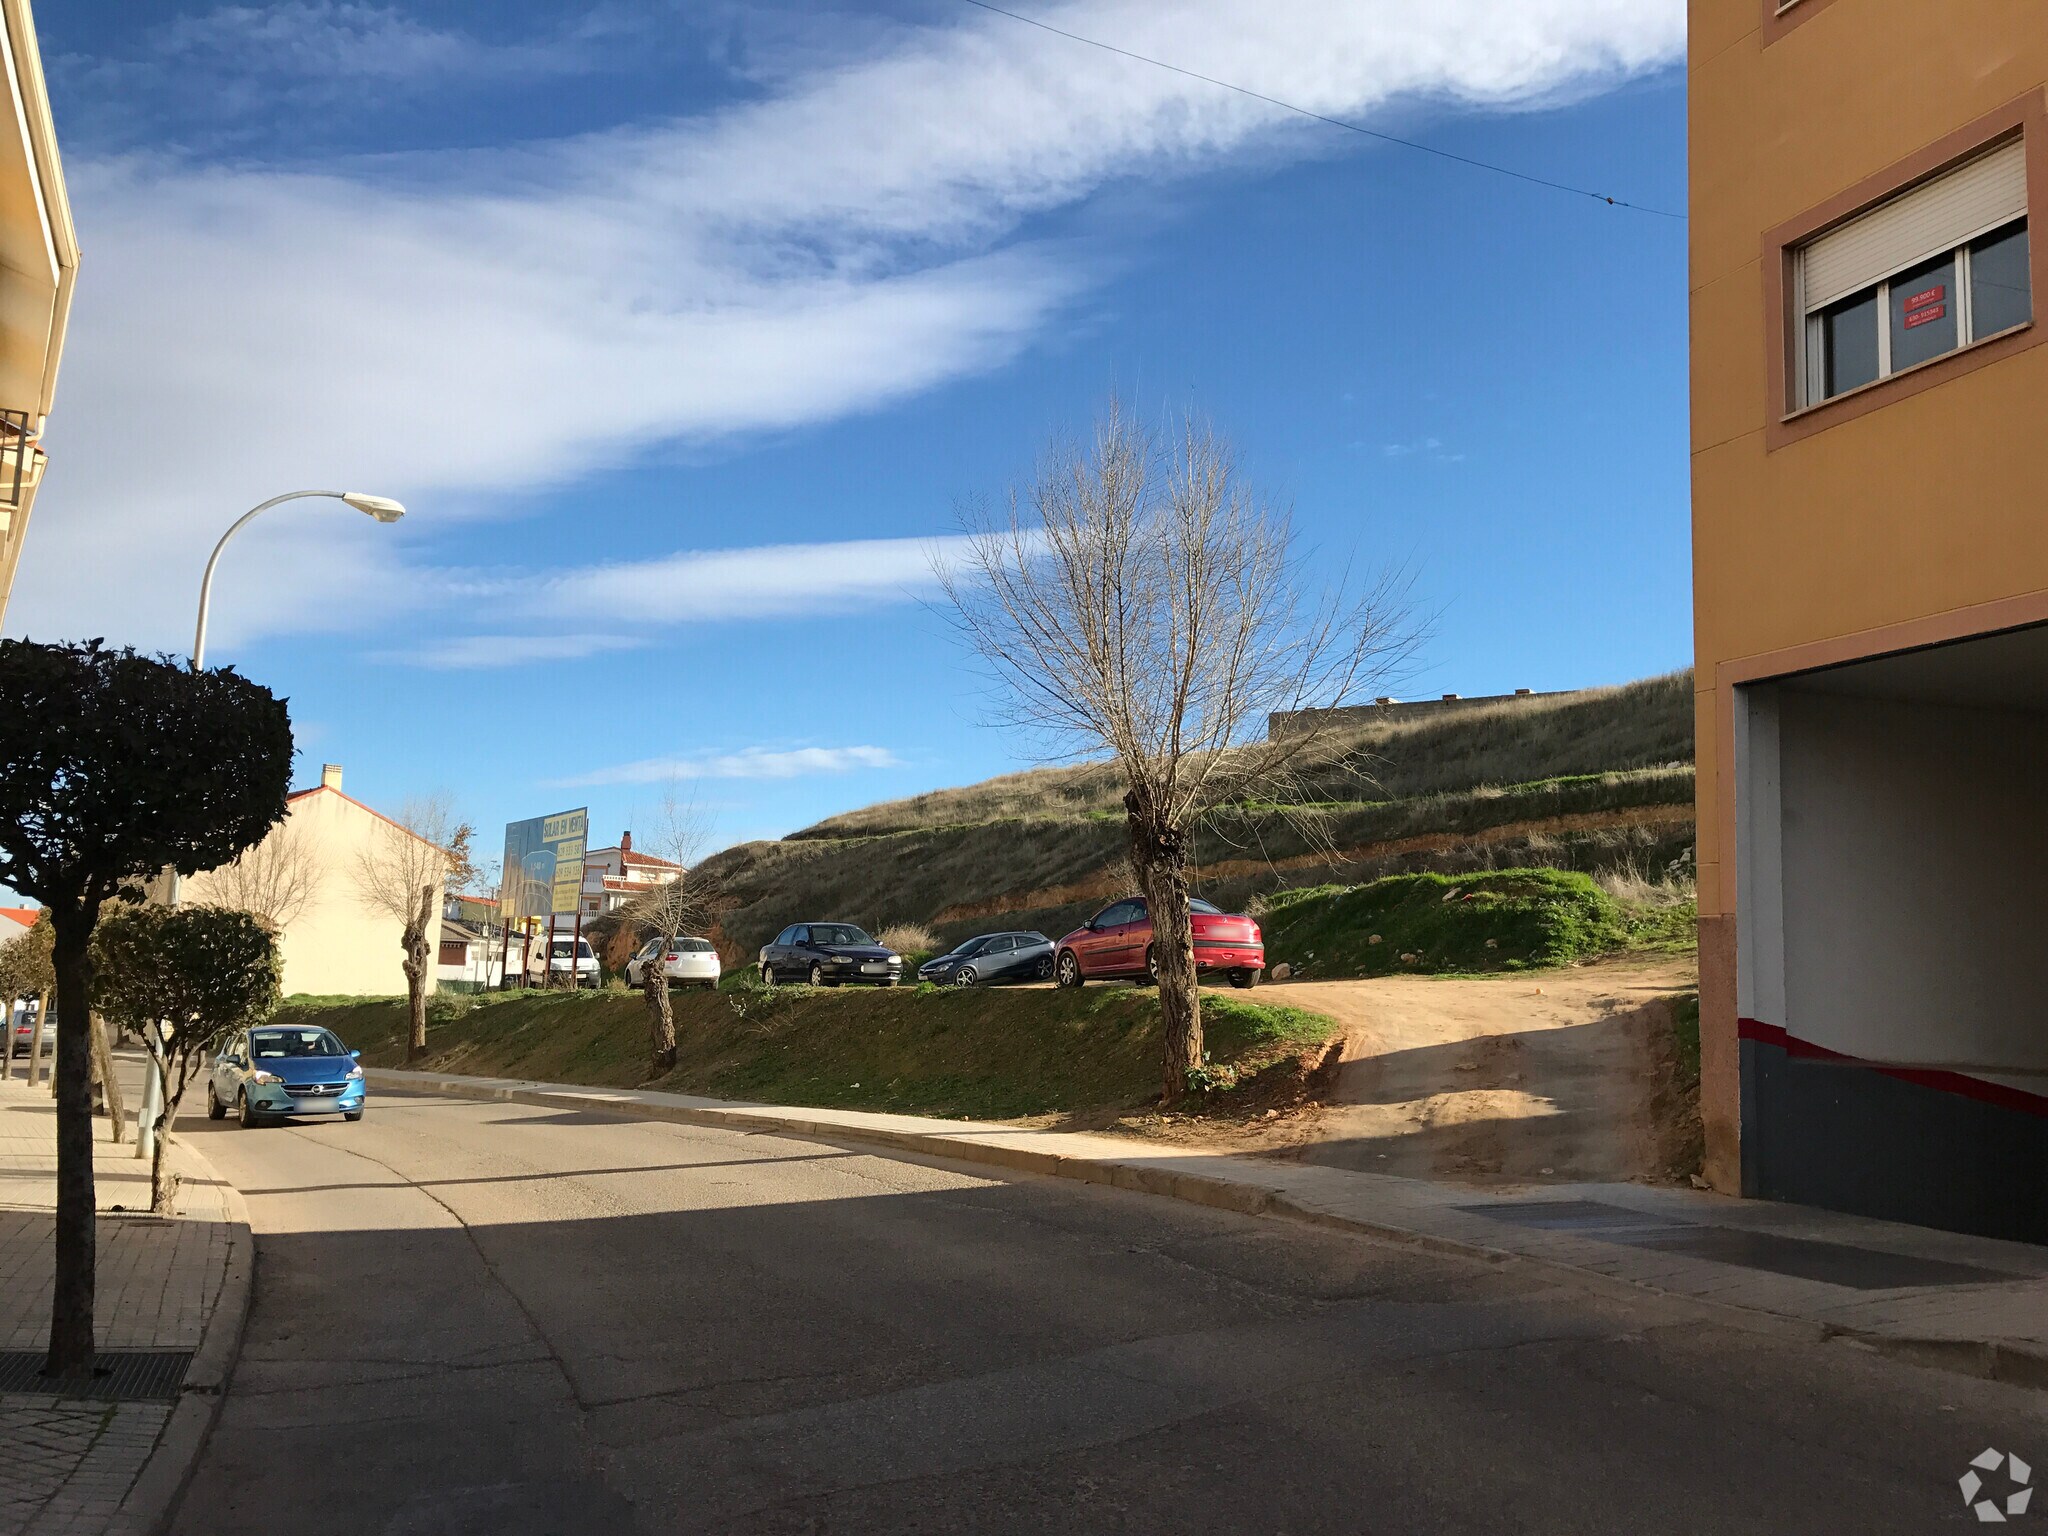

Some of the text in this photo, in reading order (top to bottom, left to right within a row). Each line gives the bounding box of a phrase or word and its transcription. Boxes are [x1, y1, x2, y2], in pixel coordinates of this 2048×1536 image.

[544, 815, 584, 838] SOLAR EN VENTA
